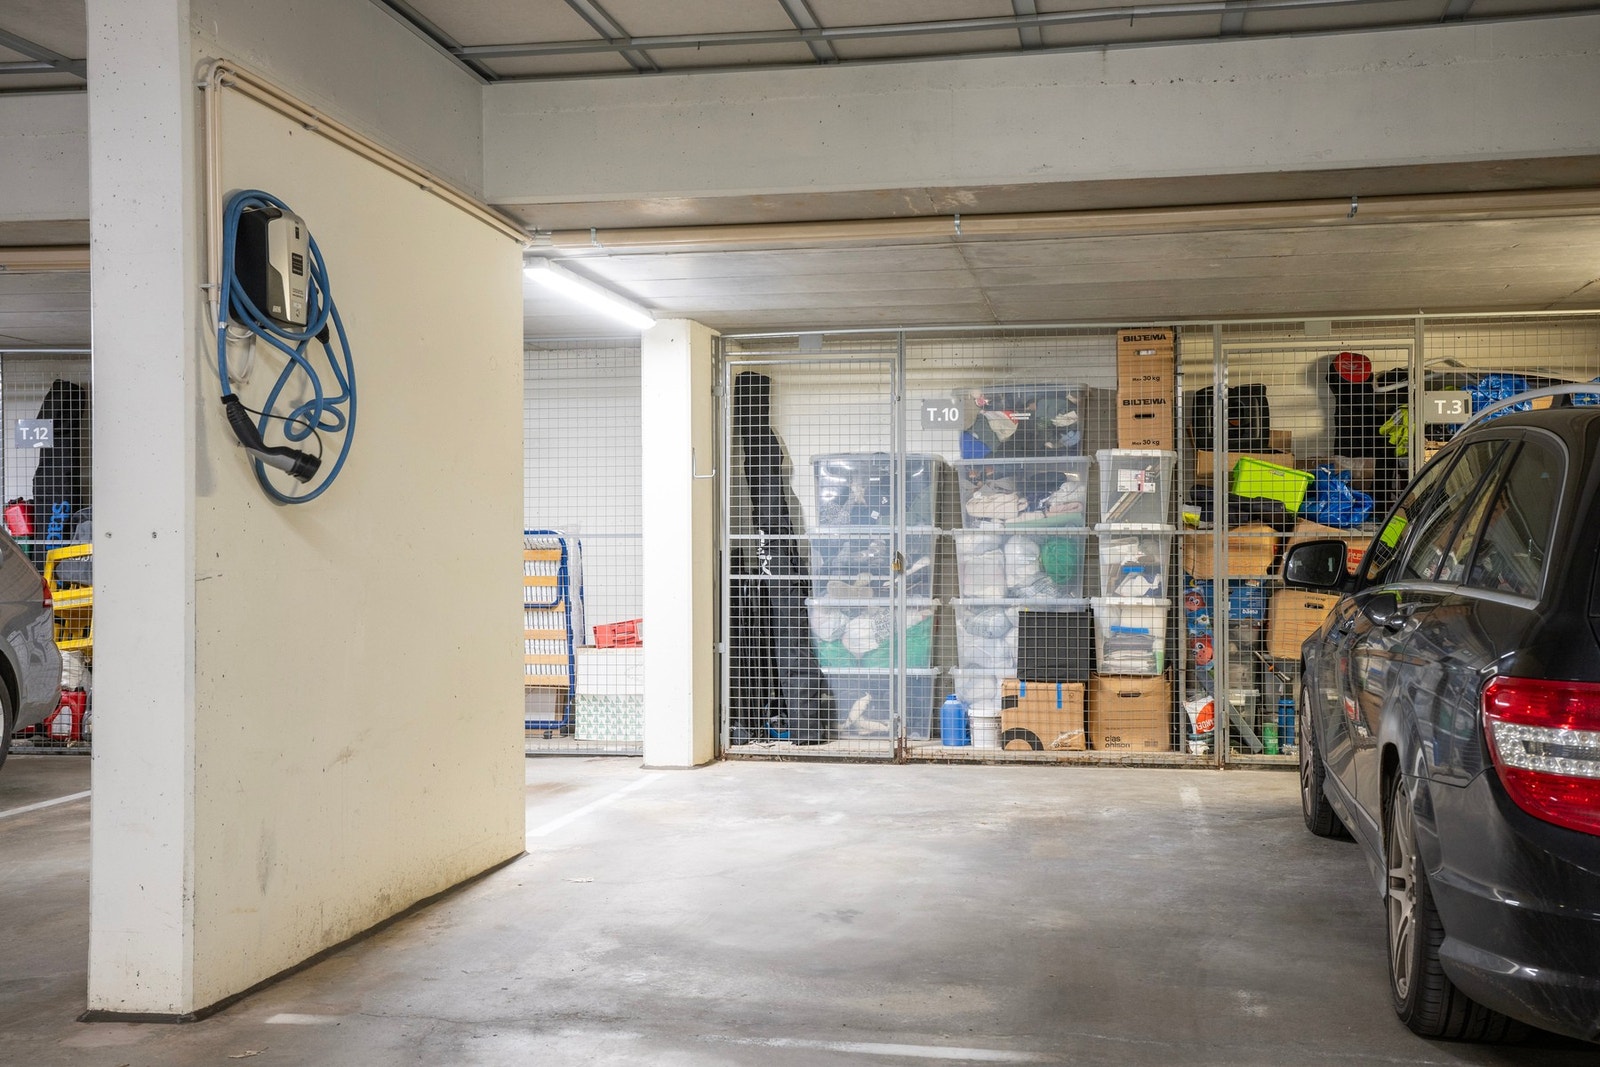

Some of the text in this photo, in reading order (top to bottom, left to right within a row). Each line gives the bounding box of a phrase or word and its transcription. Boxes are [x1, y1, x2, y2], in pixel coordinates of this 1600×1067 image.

[1123, 334, 1167, 342] BILTEMA
[1122, 398, 1167, 406] BILTEMA
[1434, 399, 1462, 415] T.3
[926, 407, 959, 422] T.10
[19, 427, 49, 440] T.12
